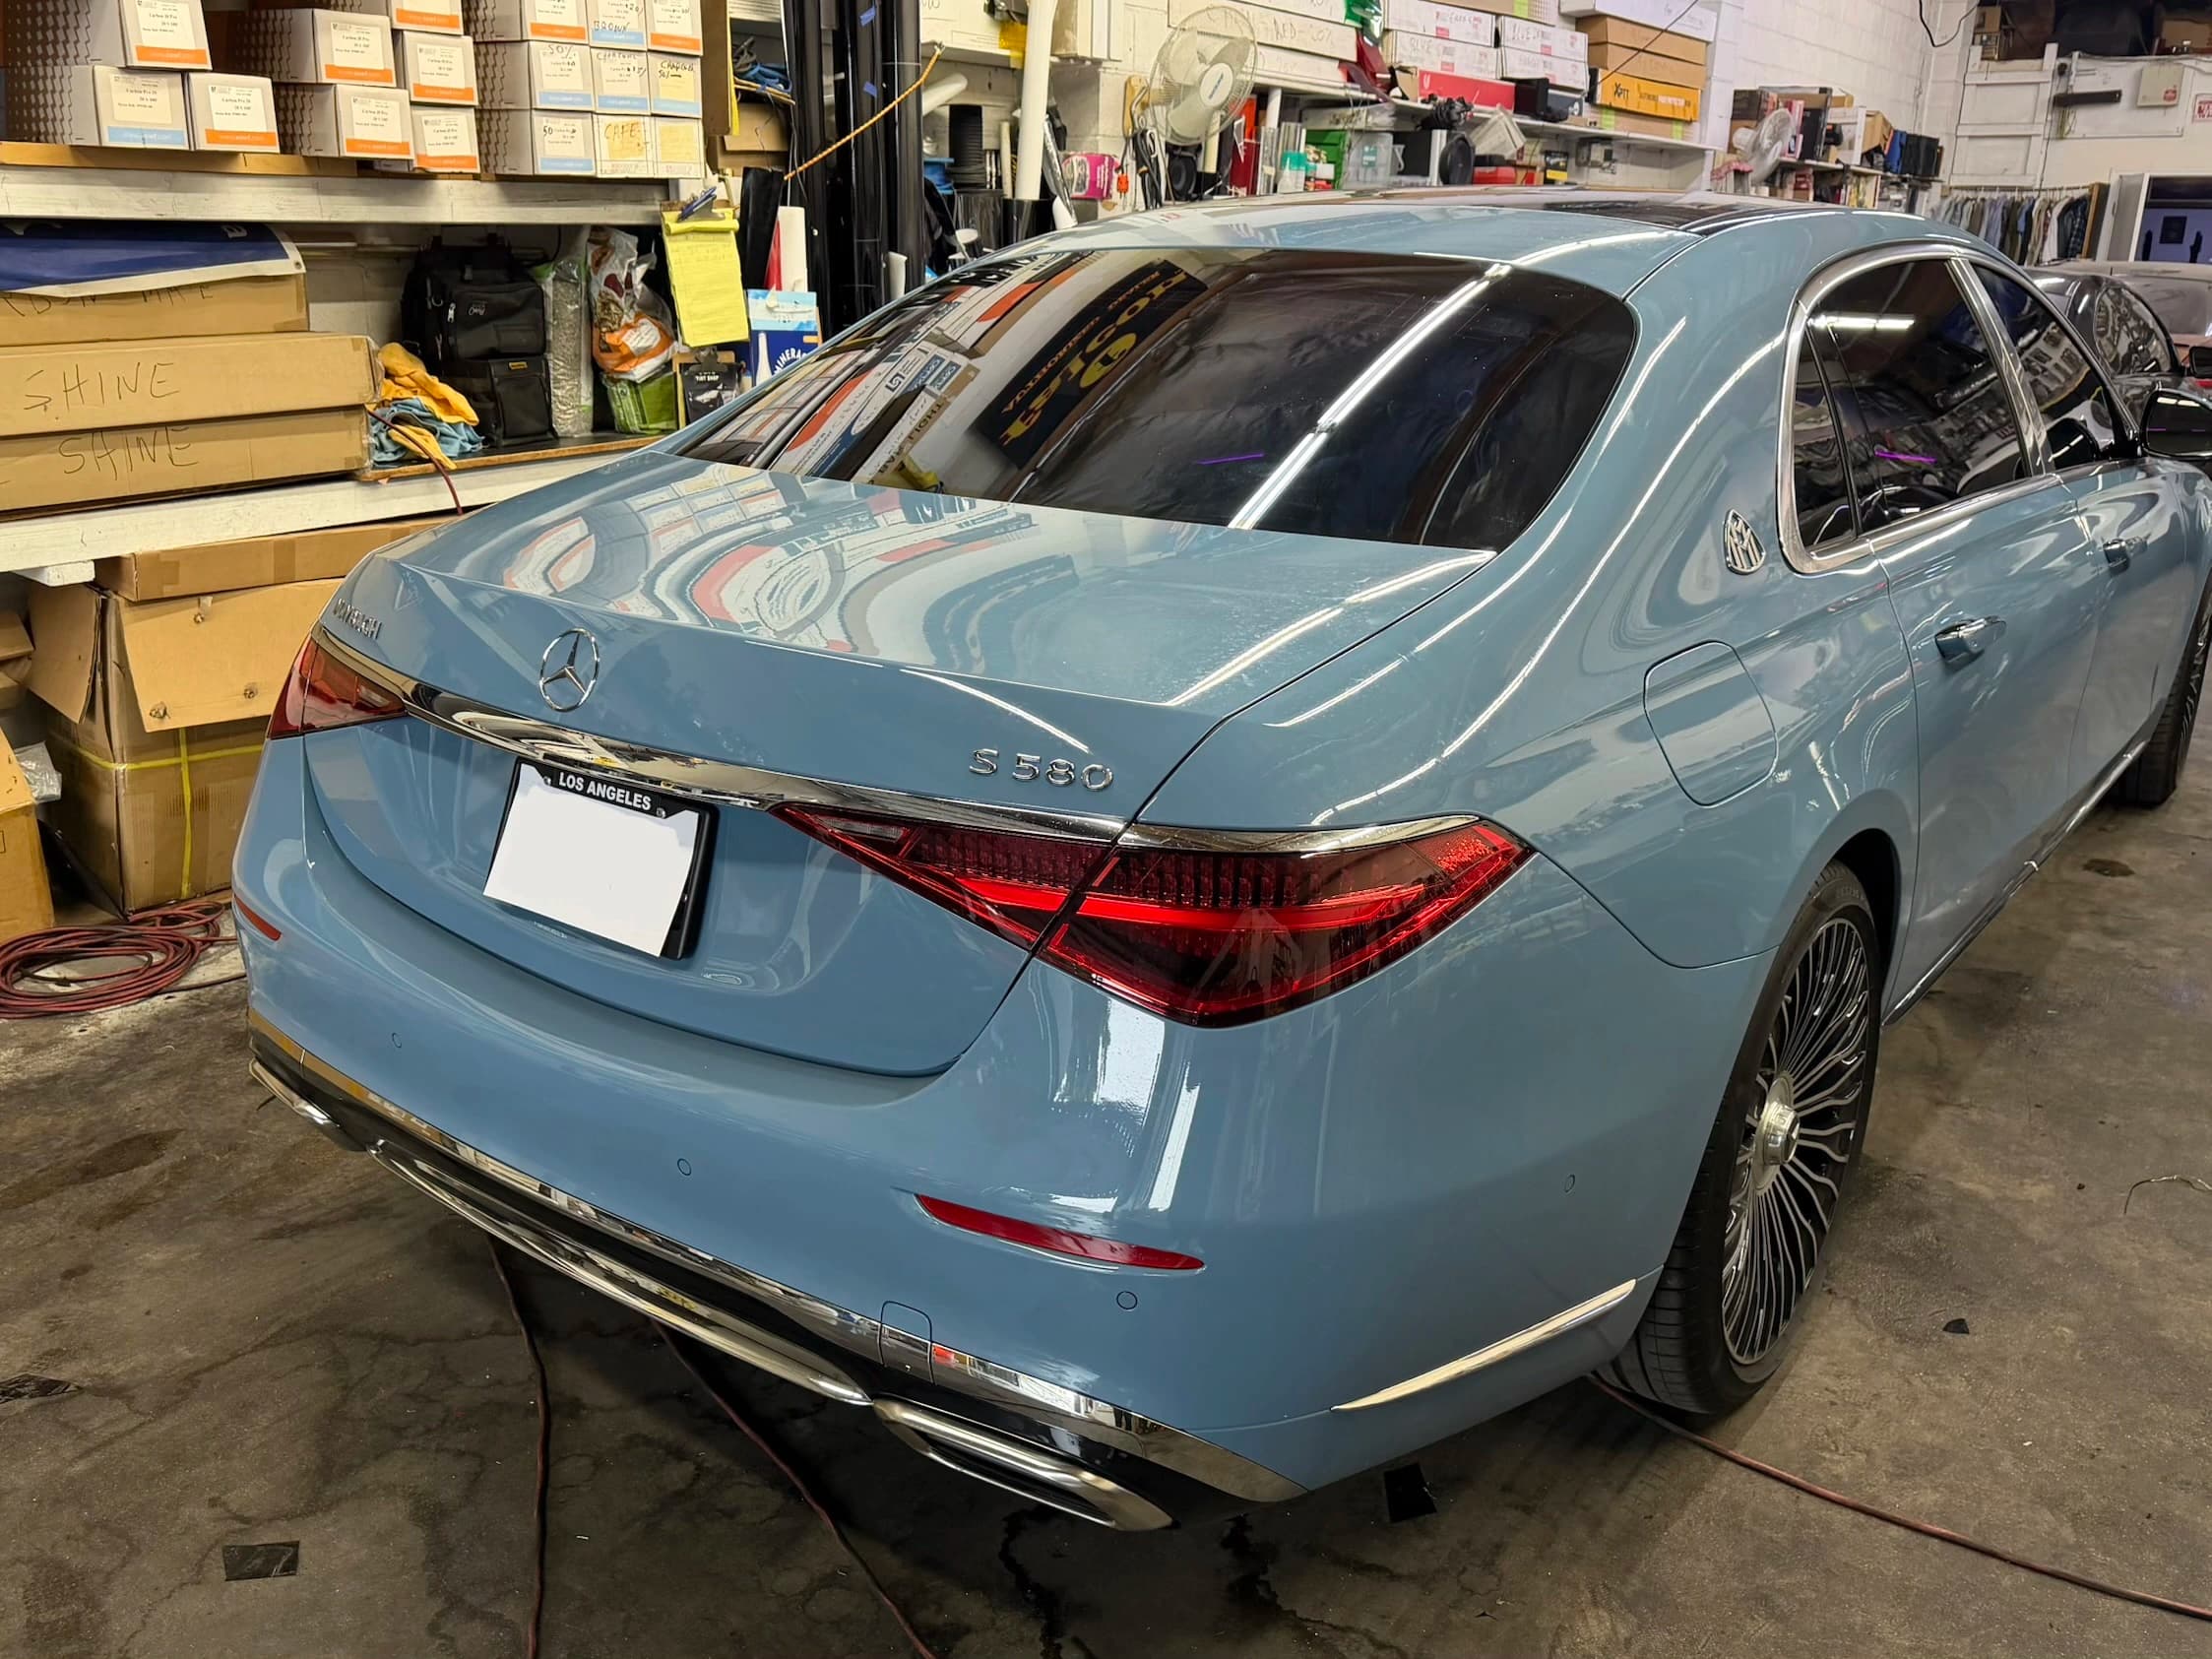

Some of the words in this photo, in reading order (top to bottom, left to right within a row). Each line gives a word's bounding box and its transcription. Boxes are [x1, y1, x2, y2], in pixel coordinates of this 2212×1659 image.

[23, 360, 180, 412] SHINE
[58, 424, 199, 481] SHINE
[558, 771, 585, 792] LOS
[586, 780, 652, 811] ANGELES
[969, 747, 999, 776] S
[1012, 752, 1114, 792] 580
